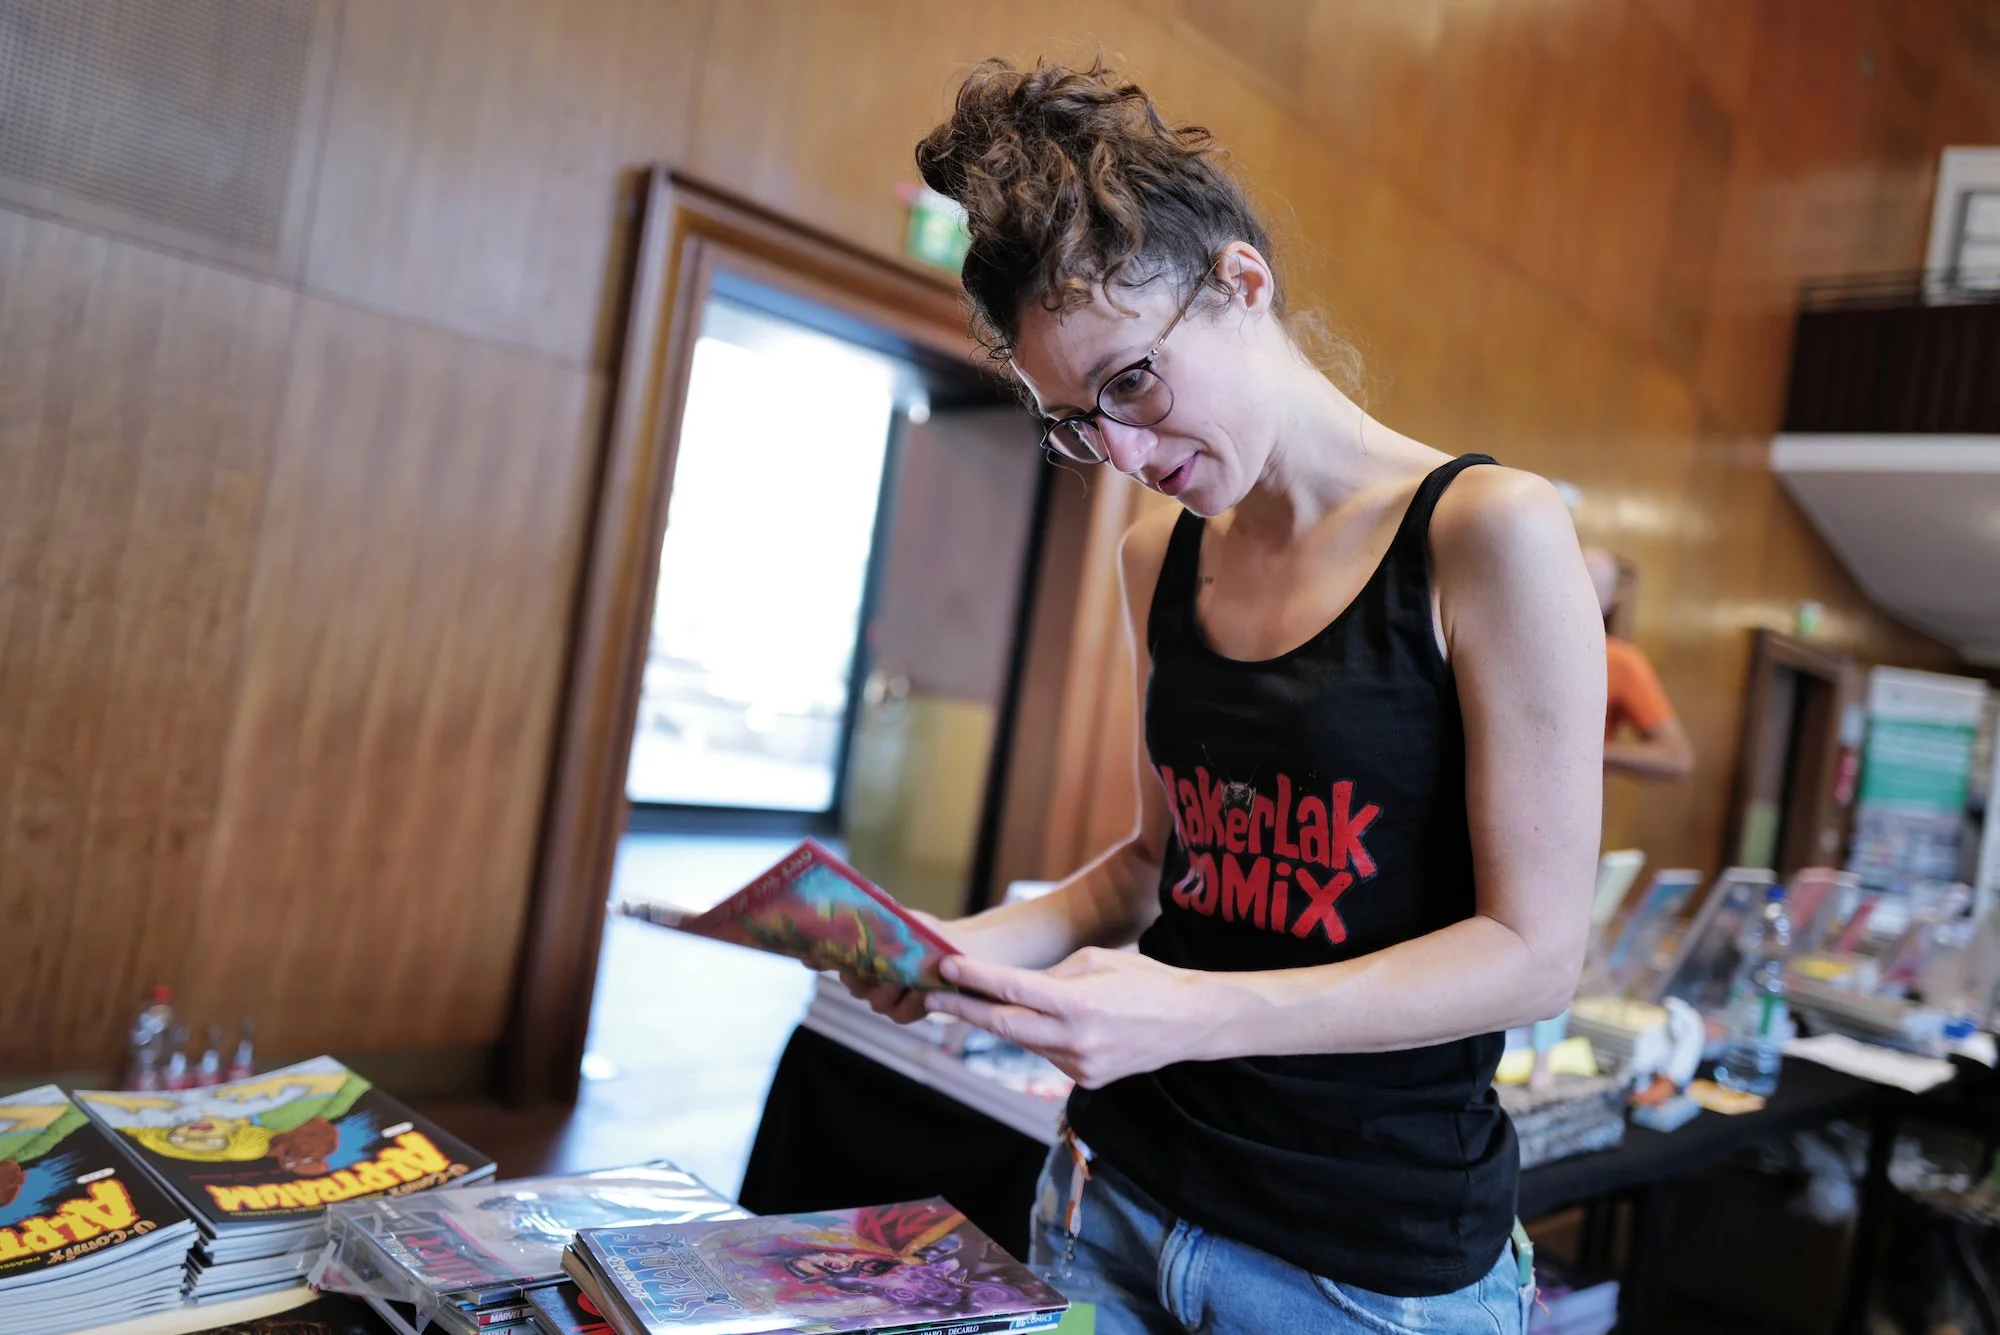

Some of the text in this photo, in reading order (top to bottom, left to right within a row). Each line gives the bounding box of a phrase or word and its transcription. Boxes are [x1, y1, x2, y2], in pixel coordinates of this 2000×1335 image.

[205, 1129, 450, 1212] ALPTRAUM
[0, 1178, 141, 1262] ALPT
[47, 1220, 157, 1264] U-Comix
[948, 1325, 979, 1335] DECARLO
